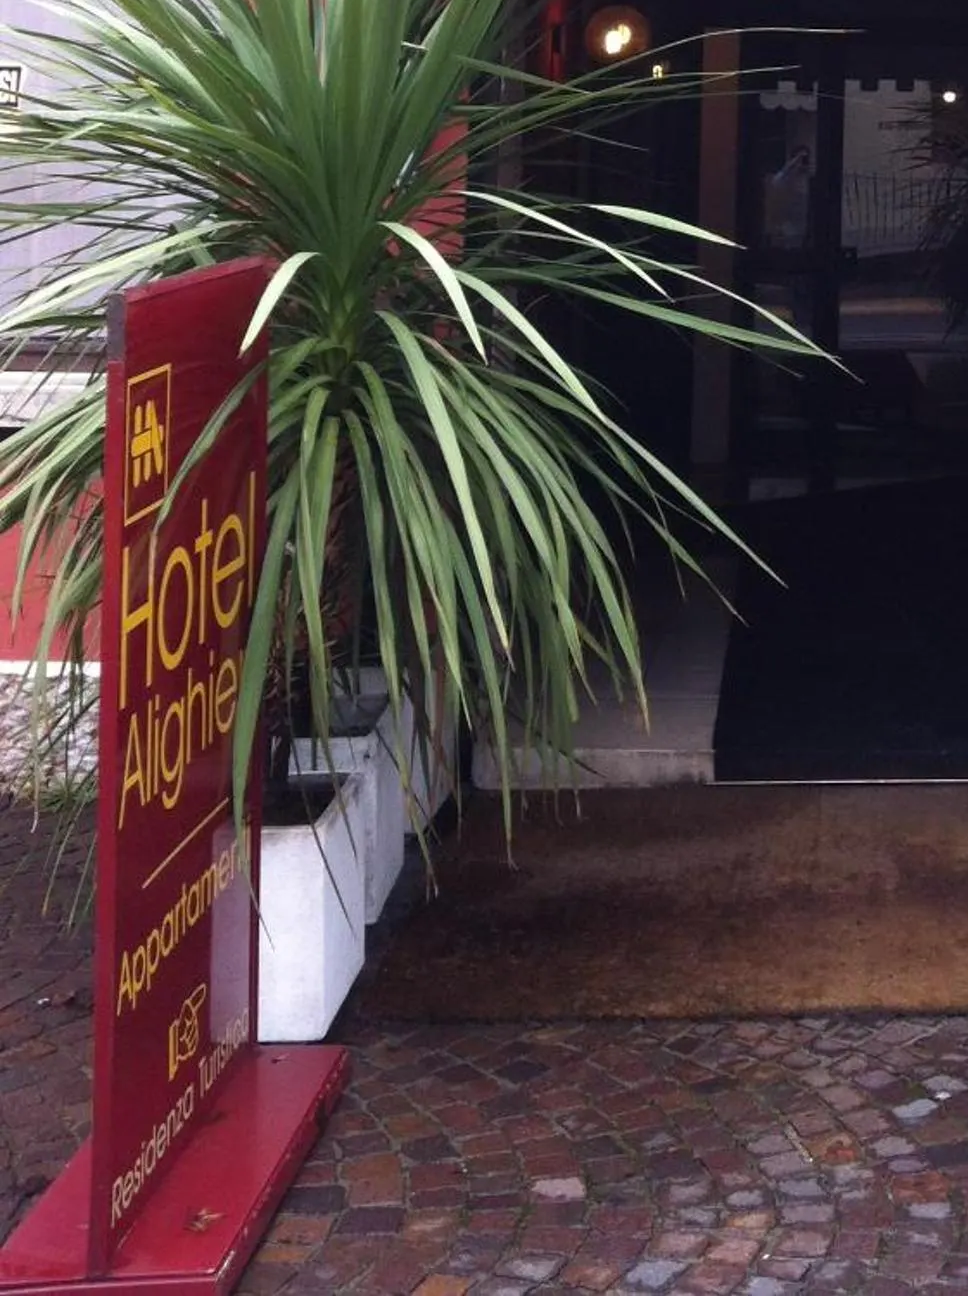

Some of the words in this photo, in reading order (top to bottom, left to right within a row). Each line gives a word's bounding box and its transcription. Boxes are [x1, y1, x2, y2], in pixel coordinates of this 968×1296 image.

[119, 470, 256, 710] Hotel
[119, 647, 243, 830] Alighie
[111, 1085, 195, 1229] Residenza
[199, 1007, 250, 1101] Turistica
